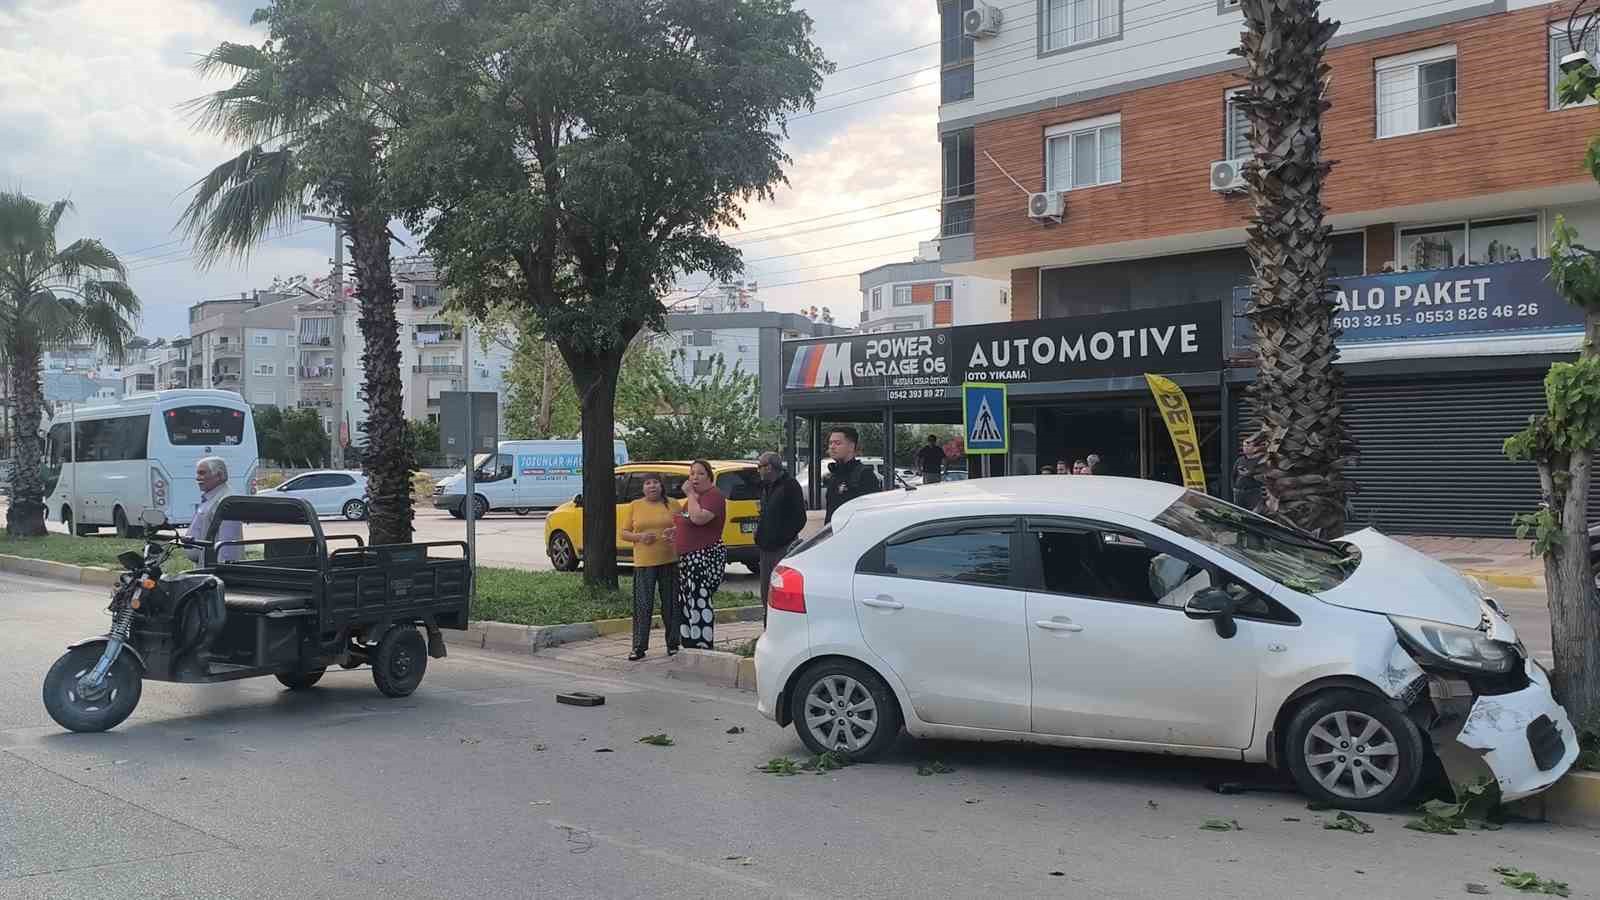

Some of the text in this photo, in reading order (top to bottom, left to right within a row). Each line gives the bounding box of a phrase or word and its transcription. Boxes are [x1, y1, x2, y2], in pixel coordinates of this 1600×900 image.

[1332, 278, 1491, 312] ALO PAKET
[1333, 316, 1360, 329] 503
[1364, 315, 1382, 327] 32
[1385, 313, 1402, 326] 15
[1415, 310, 1454, 324] 0553
[1458, 307, 1488, 321] 826
[1492, 304, 1514, 318] 46
[1517, 303, 1539, 317] 26
[866, 336, 932, 359] POWER
[969, 324, 1198, 367] AUTOMOTIVE
[854, 357, 945, 376] GARAGE 06
[967, 369, 1028, 381] OTO YIKAMA
[889, 390, 907, 400] 0542
[908, 389, 922, 399] 393
[934, 388, 945, 397] 27
[1160, 393, 1206, 492] DETAILI
